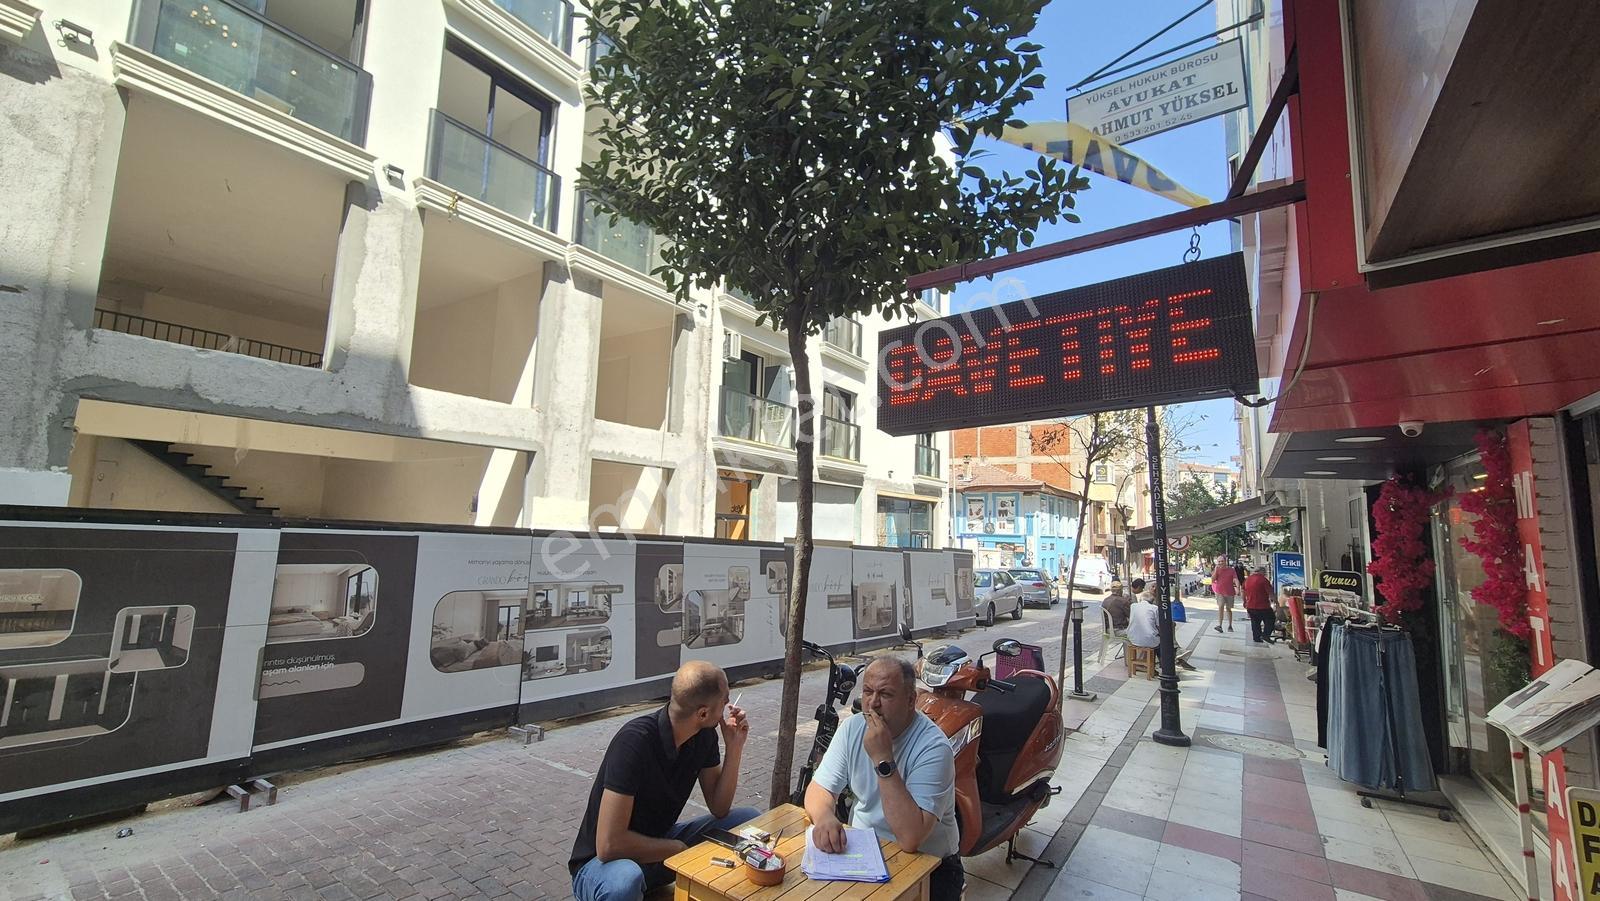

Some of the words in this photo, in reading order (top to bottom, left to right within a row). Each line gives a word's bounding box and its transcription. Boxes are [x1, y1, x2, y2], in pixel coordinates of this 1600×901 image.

[1085, 85, 1126, 105] YÜKSEL
[1128, 70, 1168, 91] HUKUK
[1170, 52, 1219, 76] BÜROSU
[1107, 74, 1197, 113] AVUKAT
[1088, 108, 1154, 137] AHMUT
[1158, 81, 1239, 117] YÜKSEL
[1323, 574, 1358, 587] Yunus
